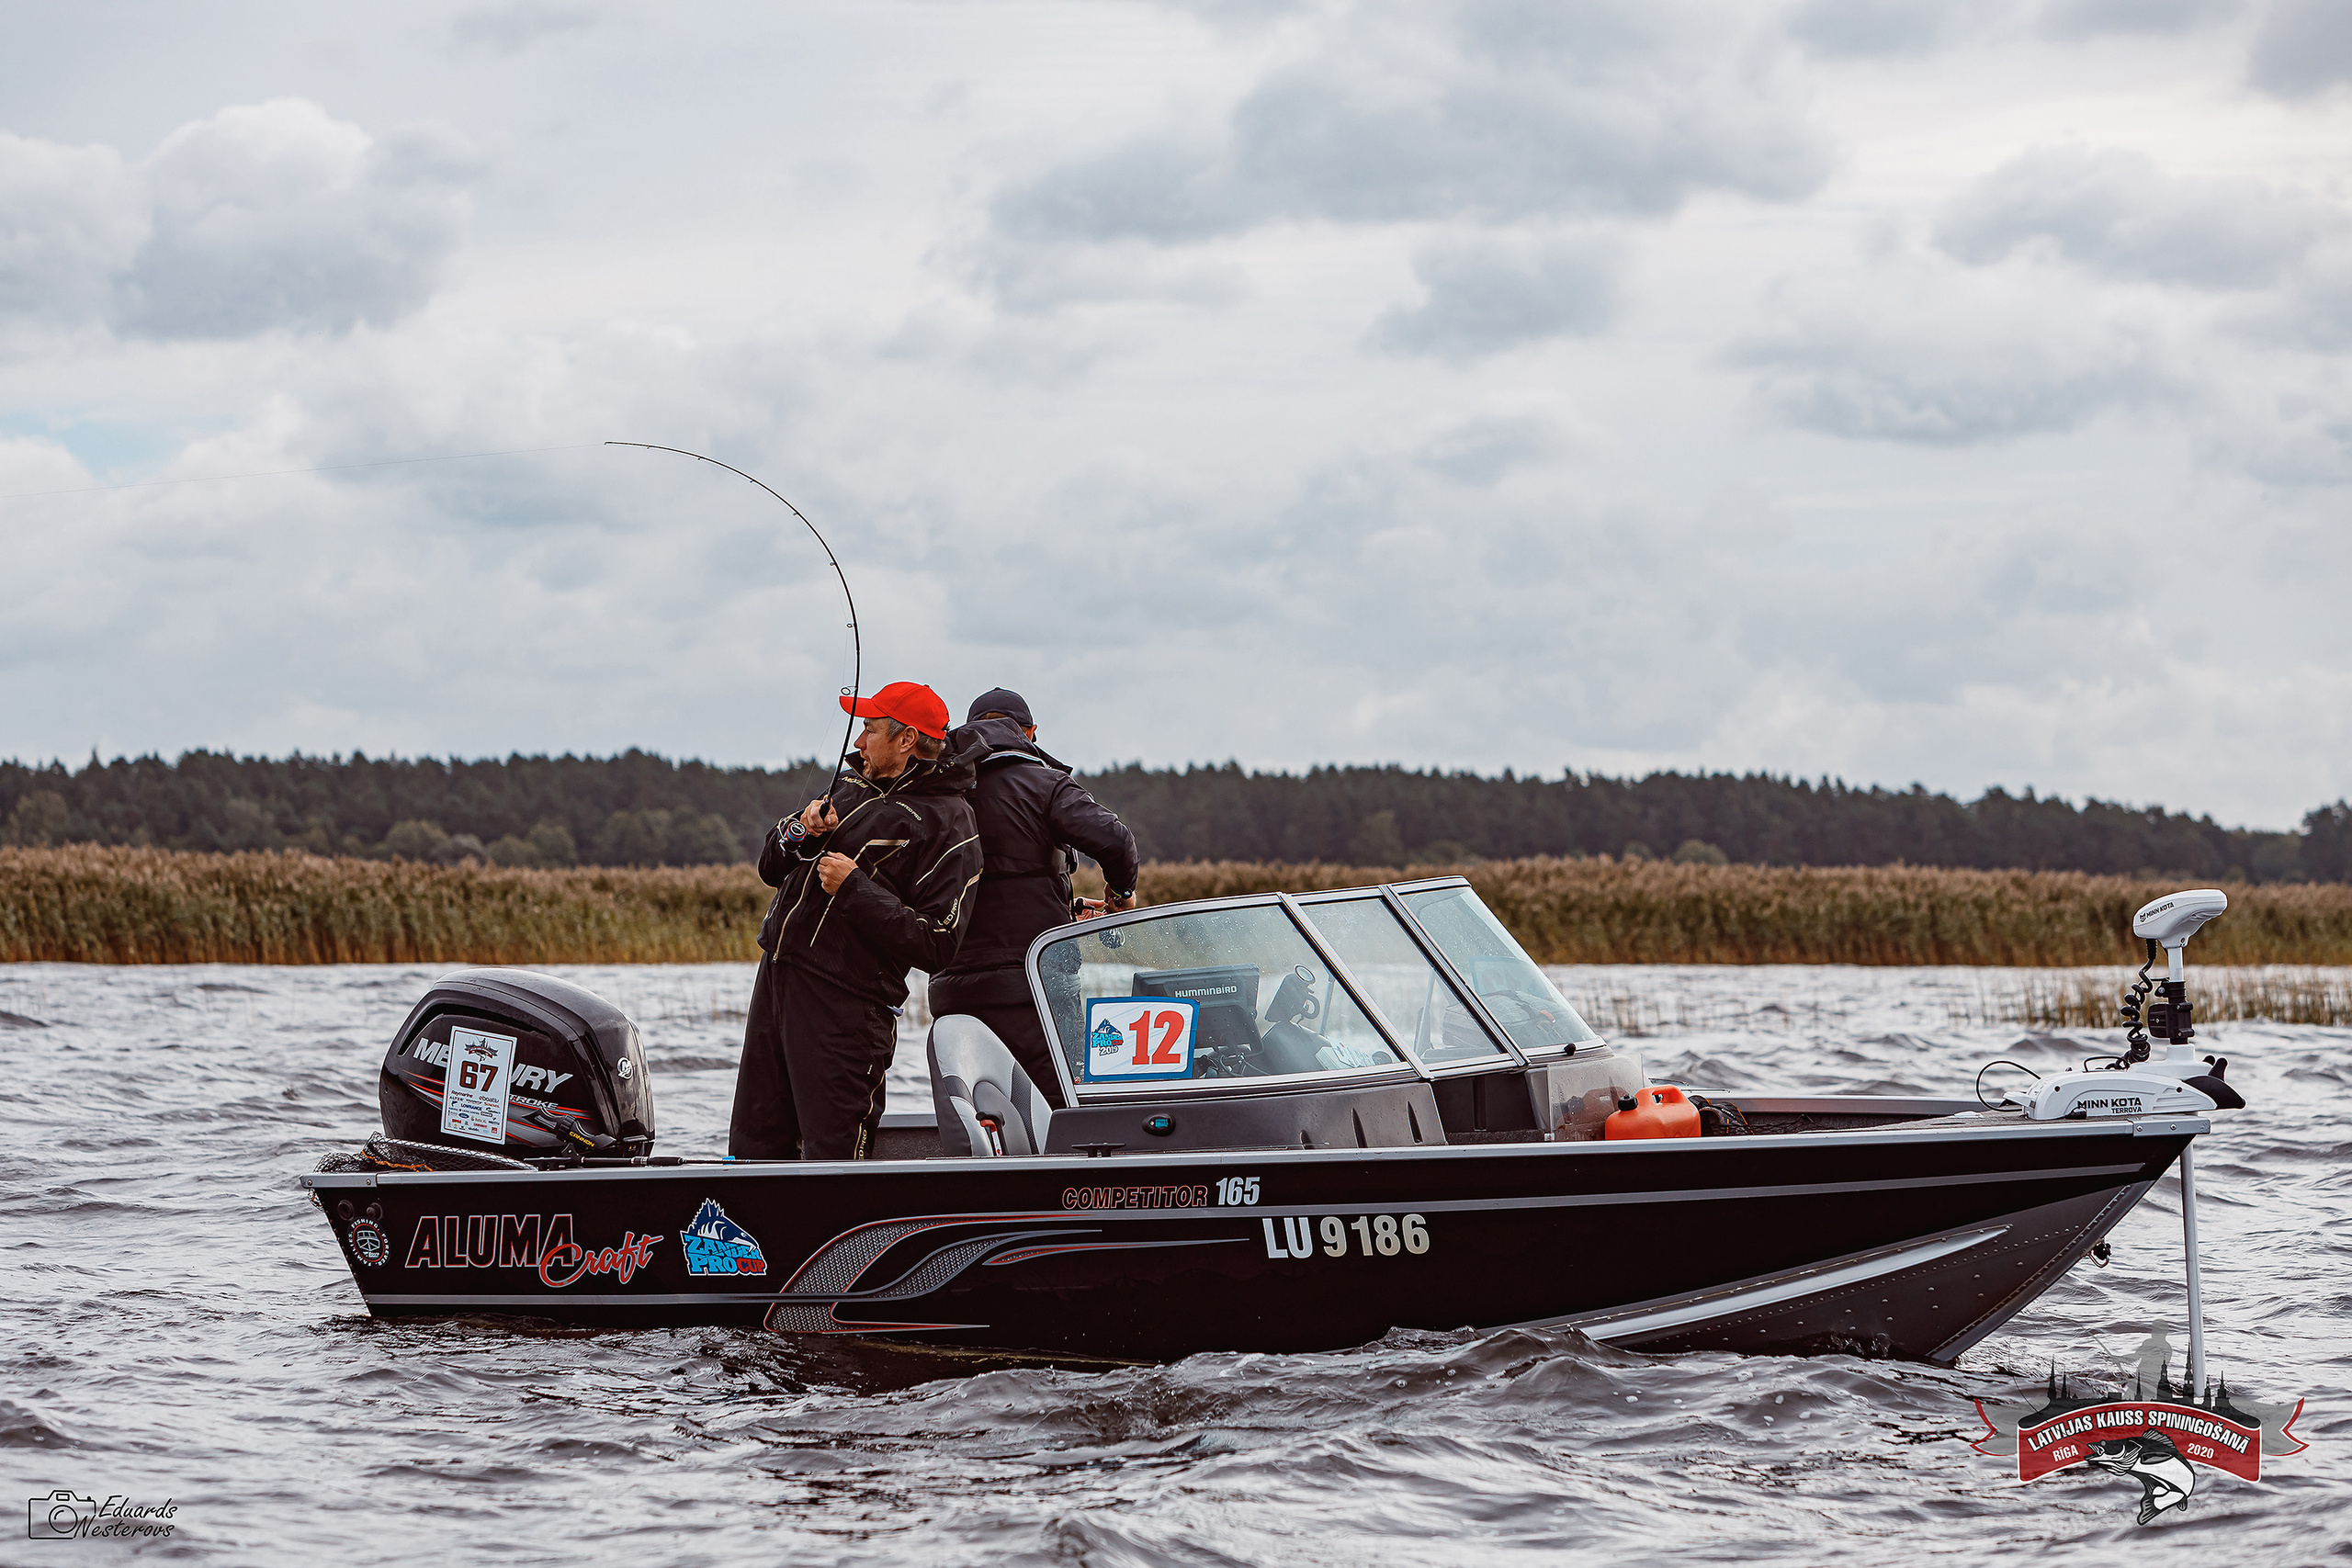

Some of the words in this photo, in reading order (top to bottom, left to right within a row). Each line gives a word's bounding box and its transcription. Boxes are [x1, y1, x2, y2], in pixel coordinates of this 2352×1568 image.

[2160, 901, 2175, 912] KOTA
[1175, 985, 1238, 998] HUMMINBIRD
[1091, 1039, 1113, 1048] PRO
[1129, 1010, 1185, 1065] 12
[1099, 1045, 1119, 1056] 2019
[459, 1060, 499, 1092] 67
[2077, 1099, 2109, 1109] MINN
[2111, 1097, 2143, 1108] KOTA
[2111, 1106, 2143, 1114] TERROVA
[569, 1131, 595, 1147] CANNON
[1061, 1185, 1208, 1210] COMPETITOR
[1216, 1176, 1261, 1206] 165
[1261, 1216, 1314, 1259] LU
[1319, 1213, 1430, 1258] 9186
[404, 1213, 575, 1269] ALUMA
[538, 1231, 664, 1288] Craft
[684, 1234, 763, 1260] ZANDER
[687, 1252, 738, 1273] PRO
[736, 1258, 765, 1273] CUP
